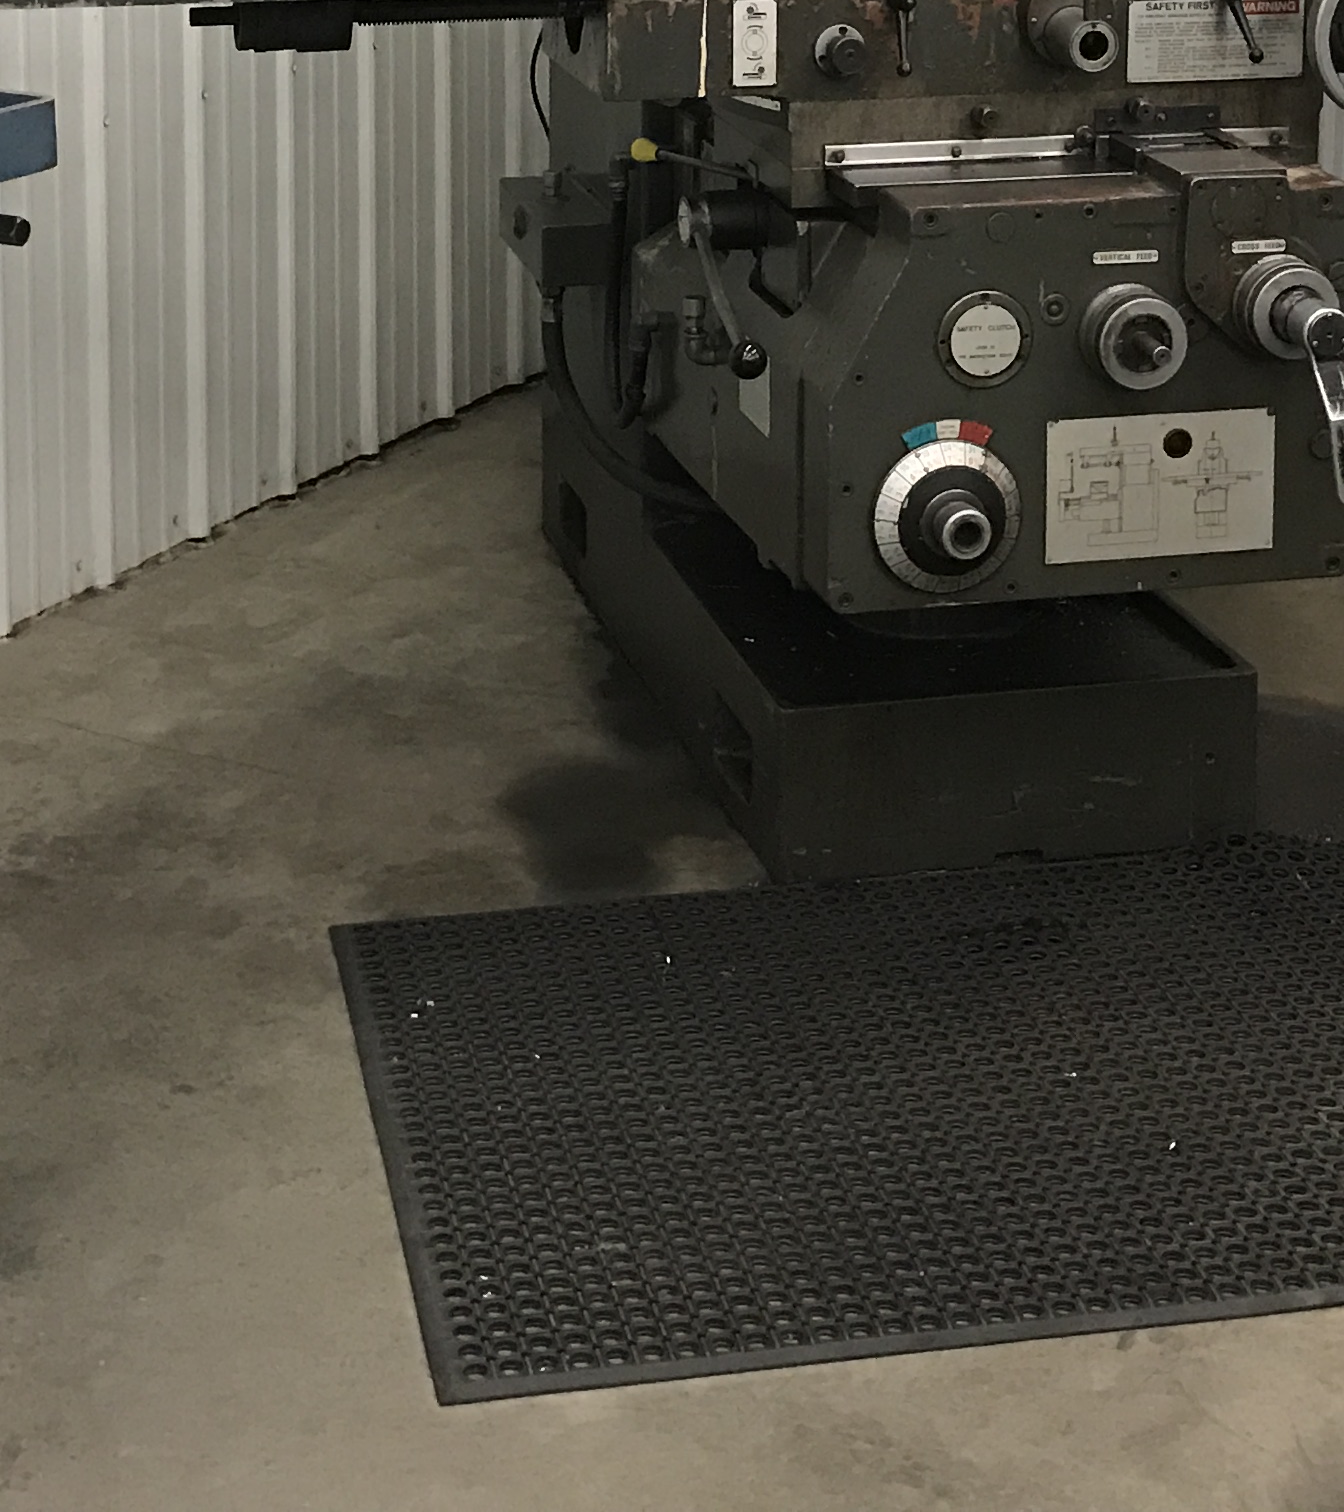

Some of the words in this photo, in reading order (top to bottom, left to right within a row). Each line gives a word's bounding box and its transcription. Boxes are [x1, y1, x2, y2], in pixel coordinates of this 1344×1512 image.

[1145, 1, 1184, 11] SAFETY
[1187, 0, 1214, 10] FIRST
[1100, 254, 1131, 262] VERTICAL
